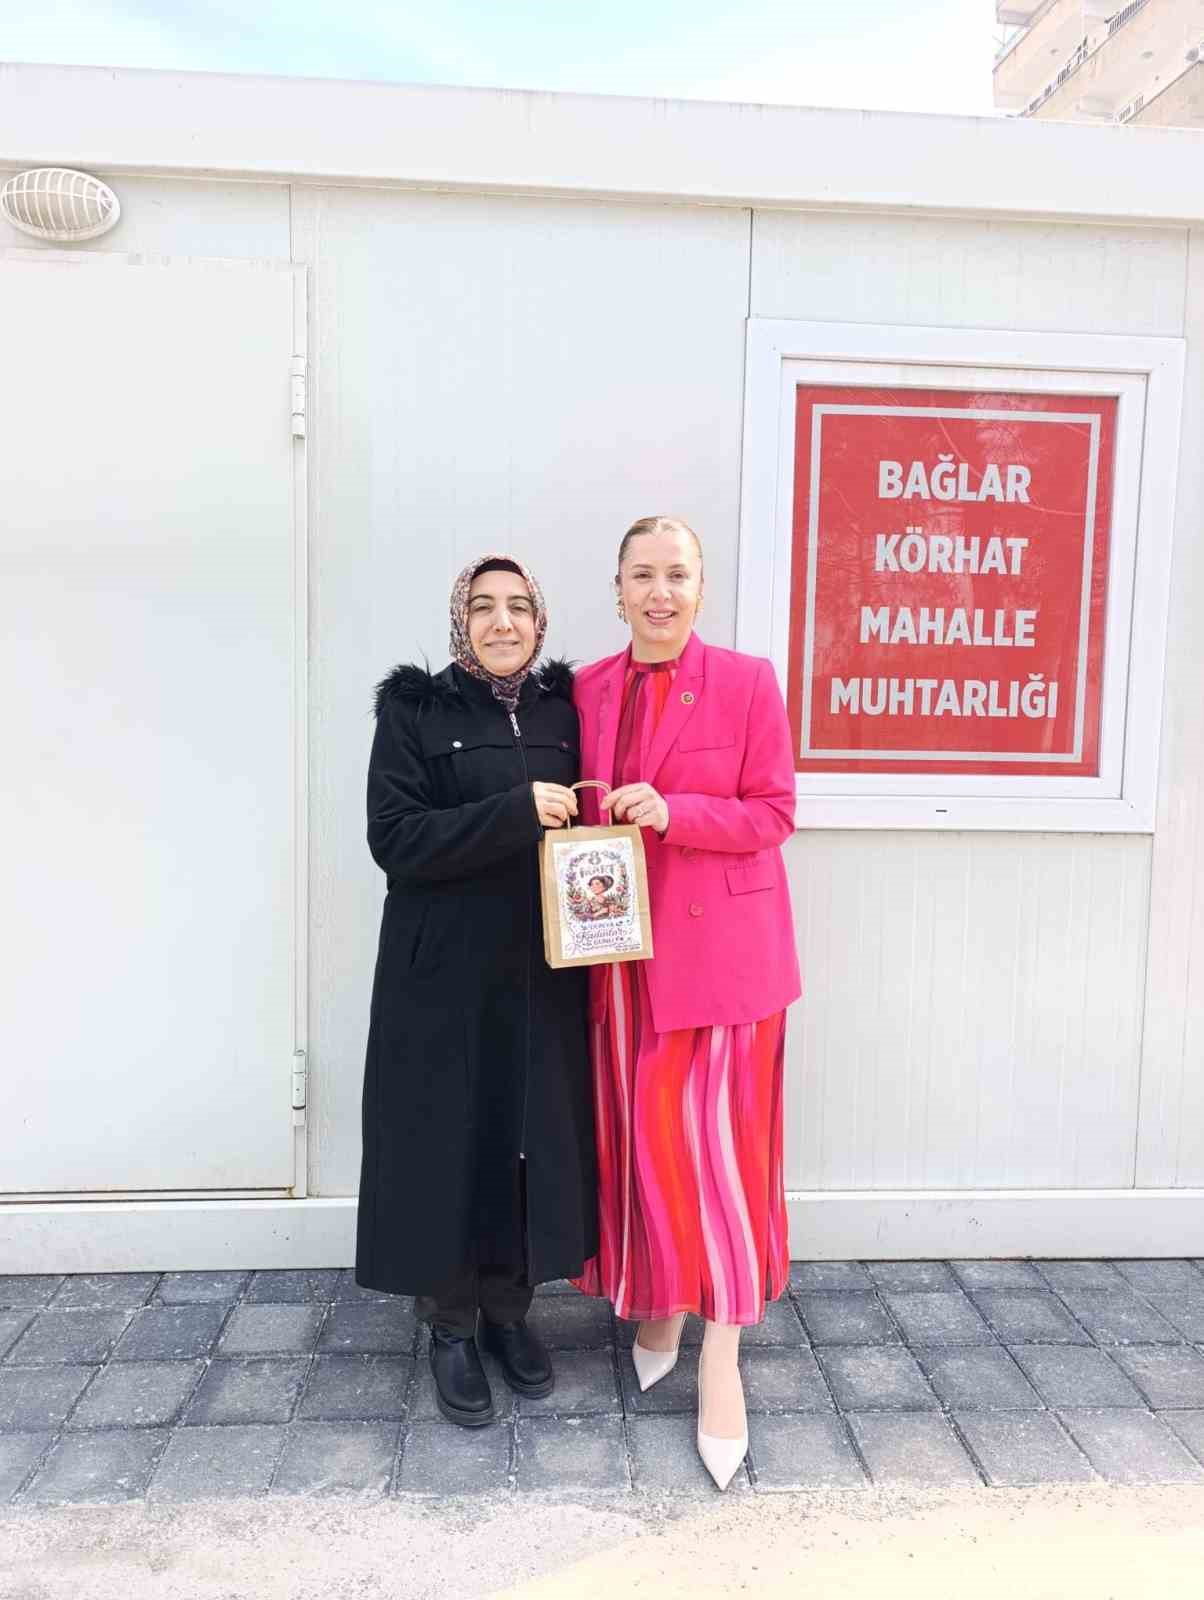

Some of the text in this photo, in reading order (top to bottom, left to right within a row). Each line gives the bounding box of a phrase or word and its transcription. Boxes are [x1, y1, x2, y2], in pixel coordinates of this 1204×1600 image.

[878, 453, 1031, 502] BAĞLAR
[874, 526, 1029, 576] KÖRHAT
[859, 606, 1037, 647] MAHALLE
[830, 672, 1059, 719] MUHTARLIĞI
